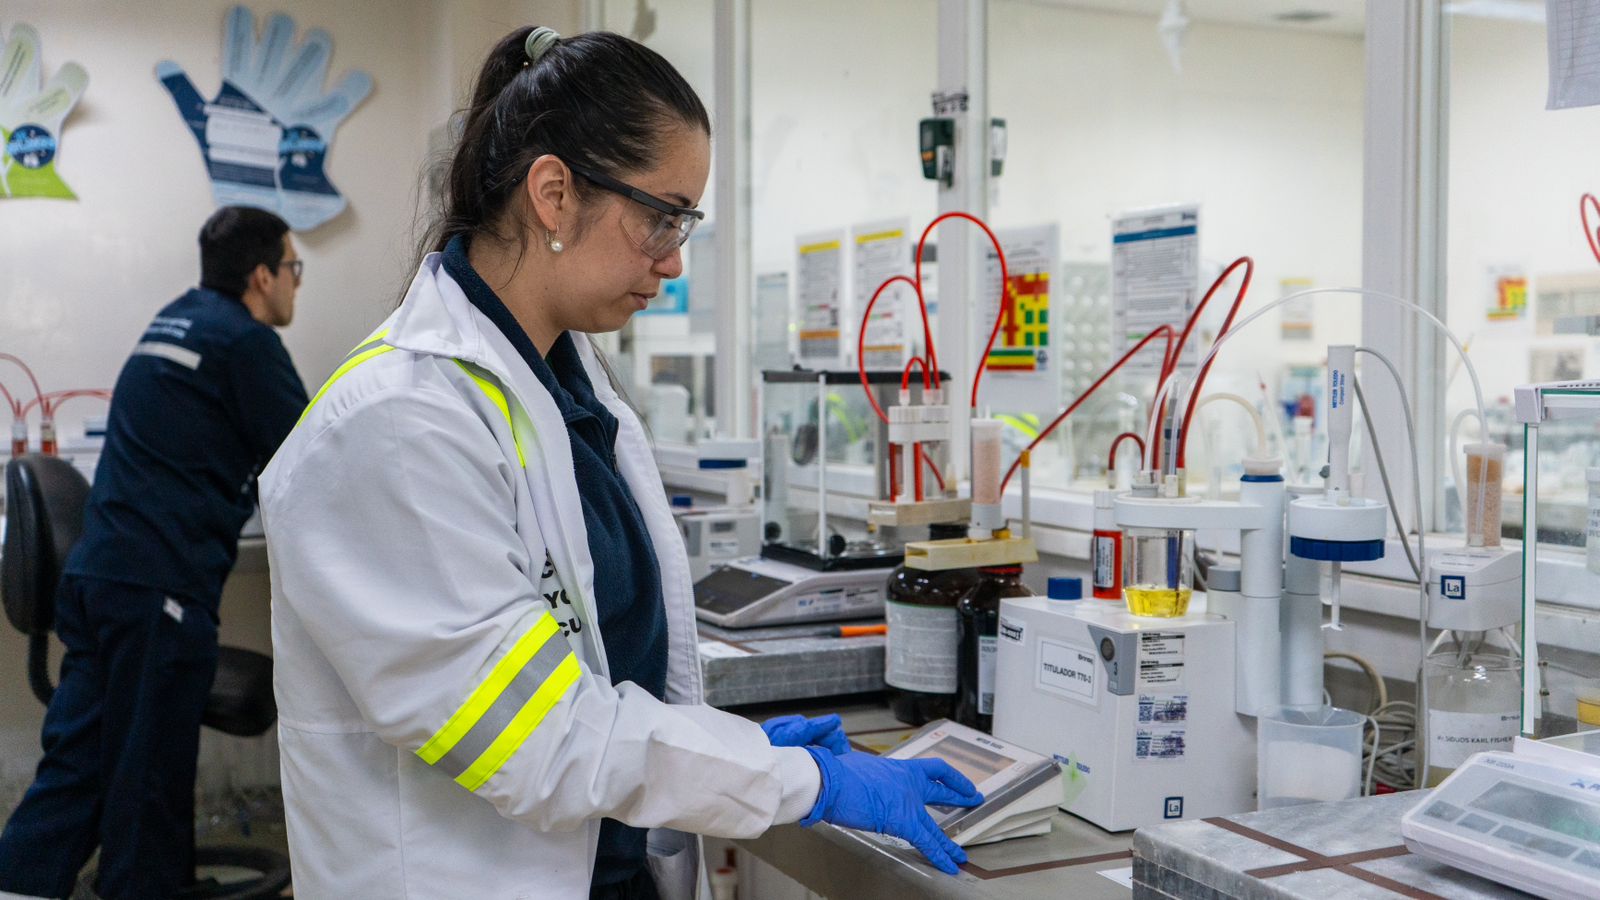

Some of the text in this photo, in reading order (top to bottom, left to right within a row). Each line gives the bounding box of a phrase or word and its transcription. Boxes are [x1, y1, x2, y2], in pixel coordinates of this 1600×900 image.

[1447, 582, 1460, 593] La
[1043, 663, 1077, 679] TITULADOR
[1168, 803, 1179, 813] La
